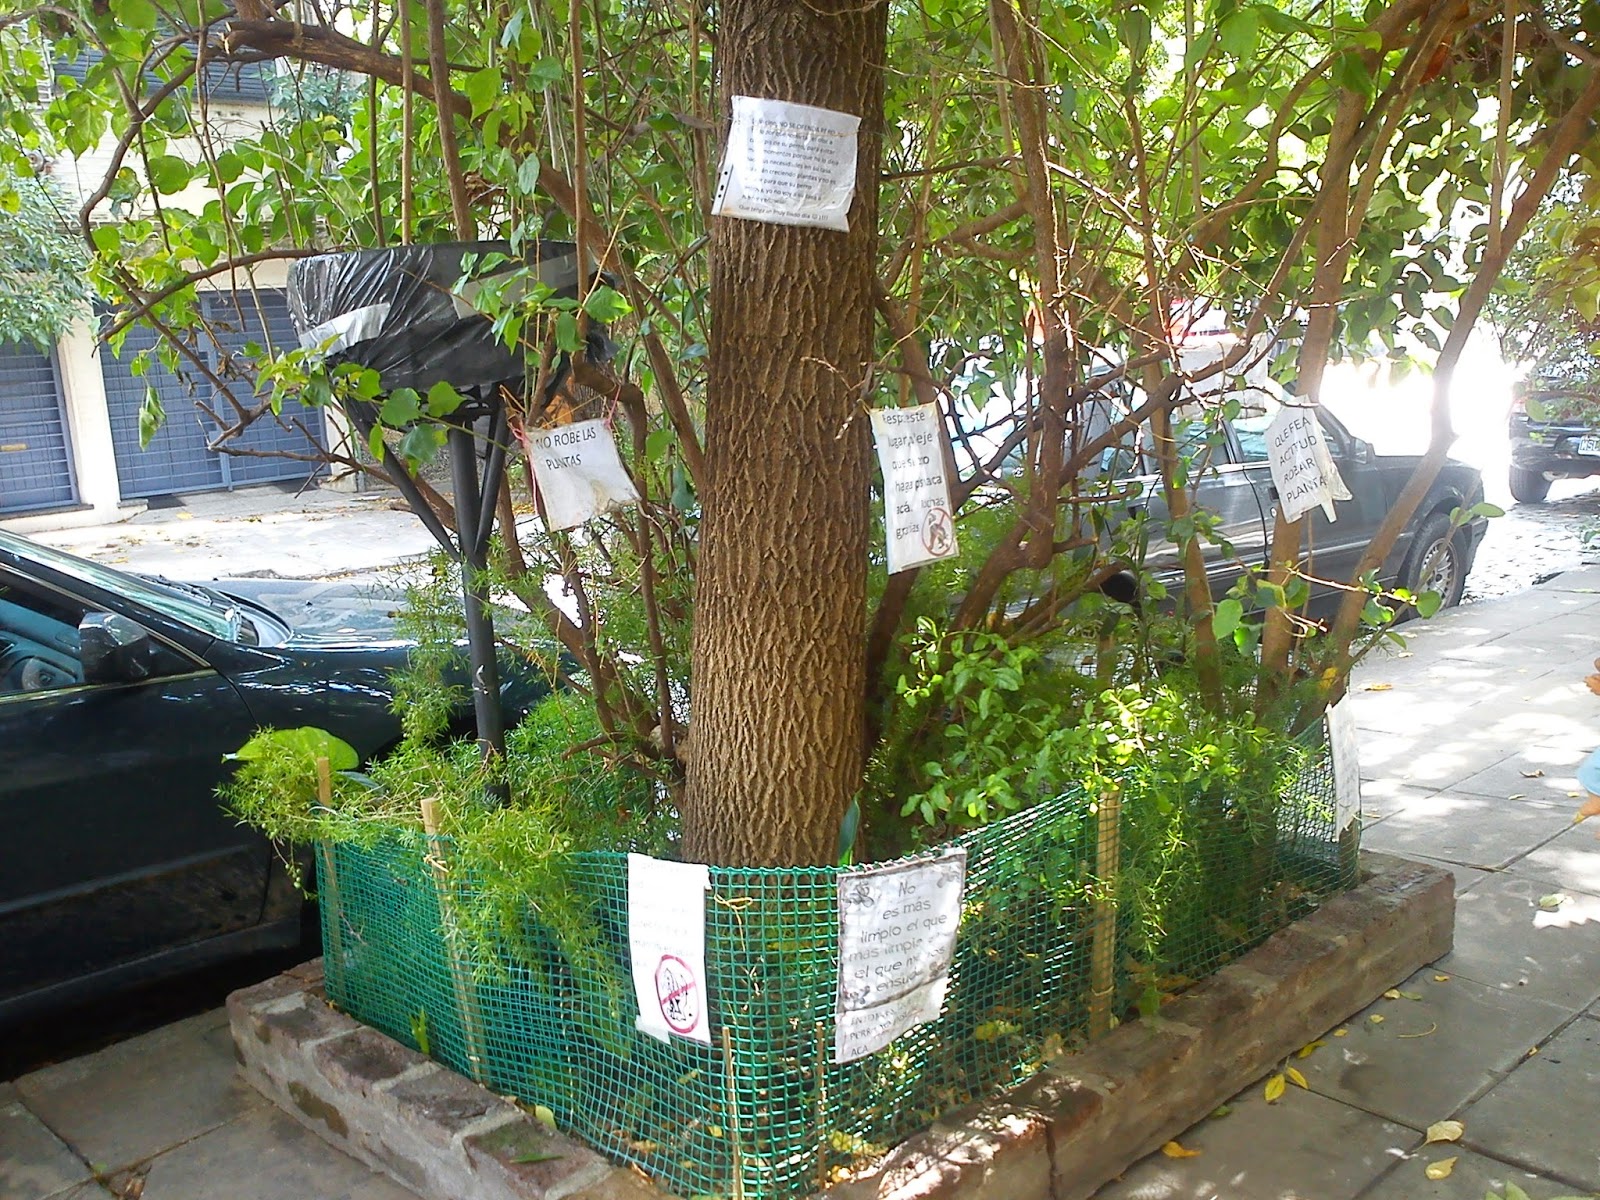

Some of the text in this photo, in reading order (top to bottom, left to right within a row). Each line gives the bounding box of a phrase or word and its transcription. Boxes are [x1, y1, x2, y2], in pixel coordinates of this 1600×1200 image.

[536, 427, 597, 450] NO ROBE LAS
[545, 453, 582, 471] PLANTAS
[1283, 457, 1315, 484] ROBAR
[899, 881, 916, 897] No
[882, 907, 899, 919] es
[923, 914, 947, 930] que
[854, 965, 869, 979] el
[875, 961, 902, 977] que
